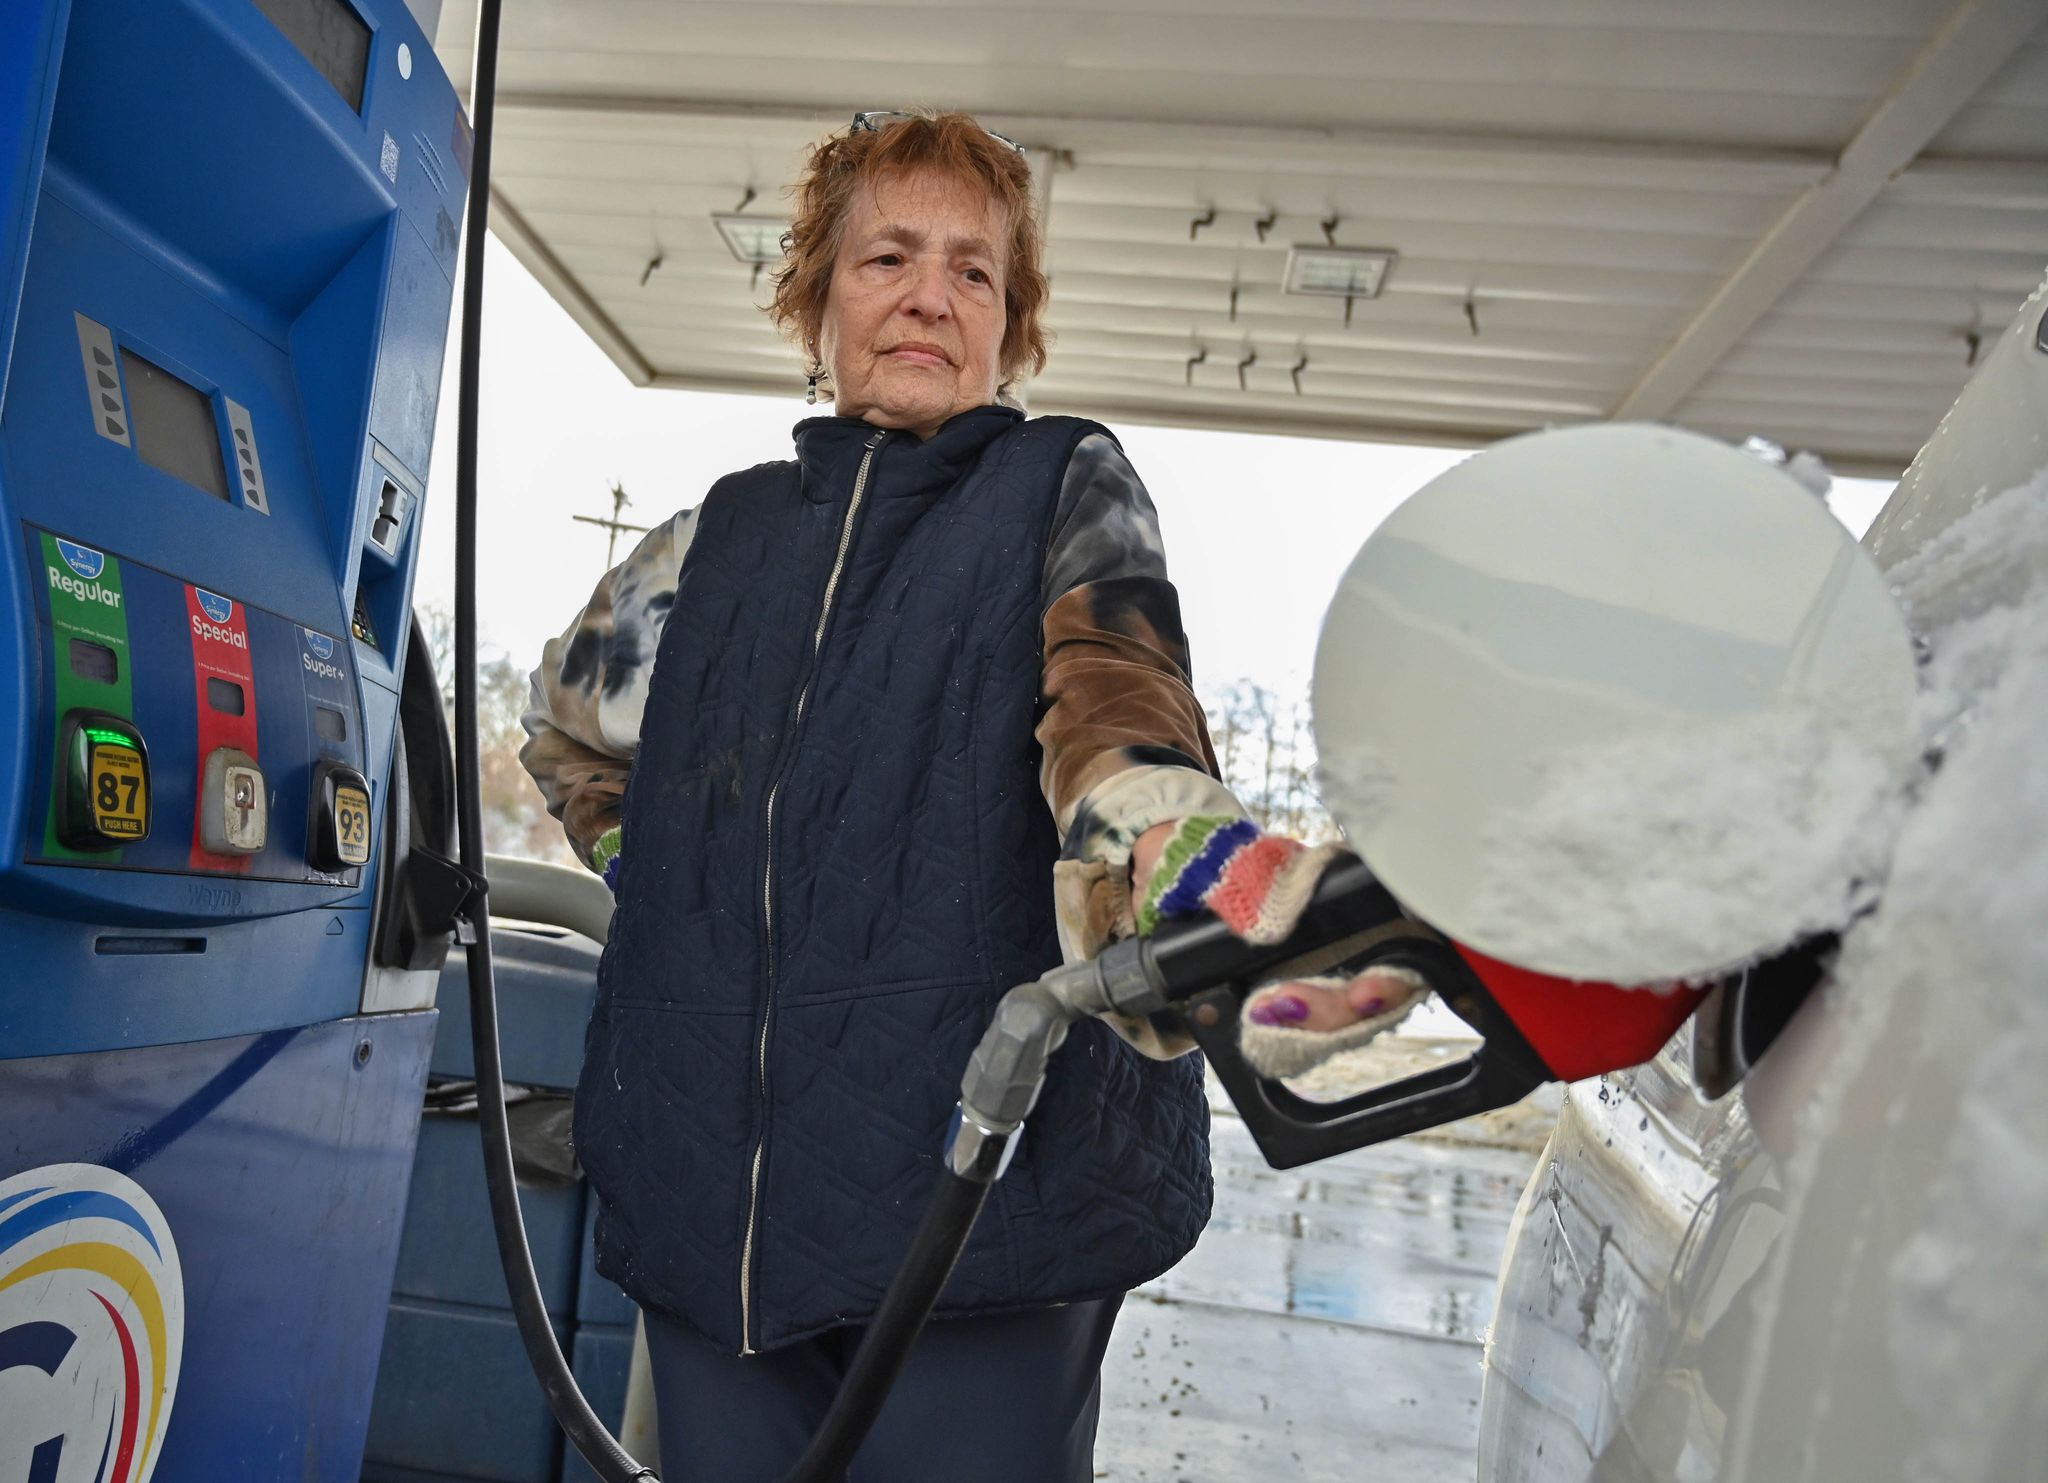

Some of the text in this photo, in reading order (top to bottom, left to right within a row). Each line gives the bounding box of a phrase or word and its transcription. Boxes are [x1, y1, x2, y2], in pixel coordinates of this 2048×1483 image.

[70, 558, 96, 575] Synergy
[48, 566, 120, 608] Regular
[192, 614, 247, 650] Special
[303, 652, 345, 681] Super+
[97, 772, 140, 814] 87
[105, 819, 138, 831] PUSH HERE
[340, 808, 364, 843] 93
[186, 883, 241, 912] Wayne
